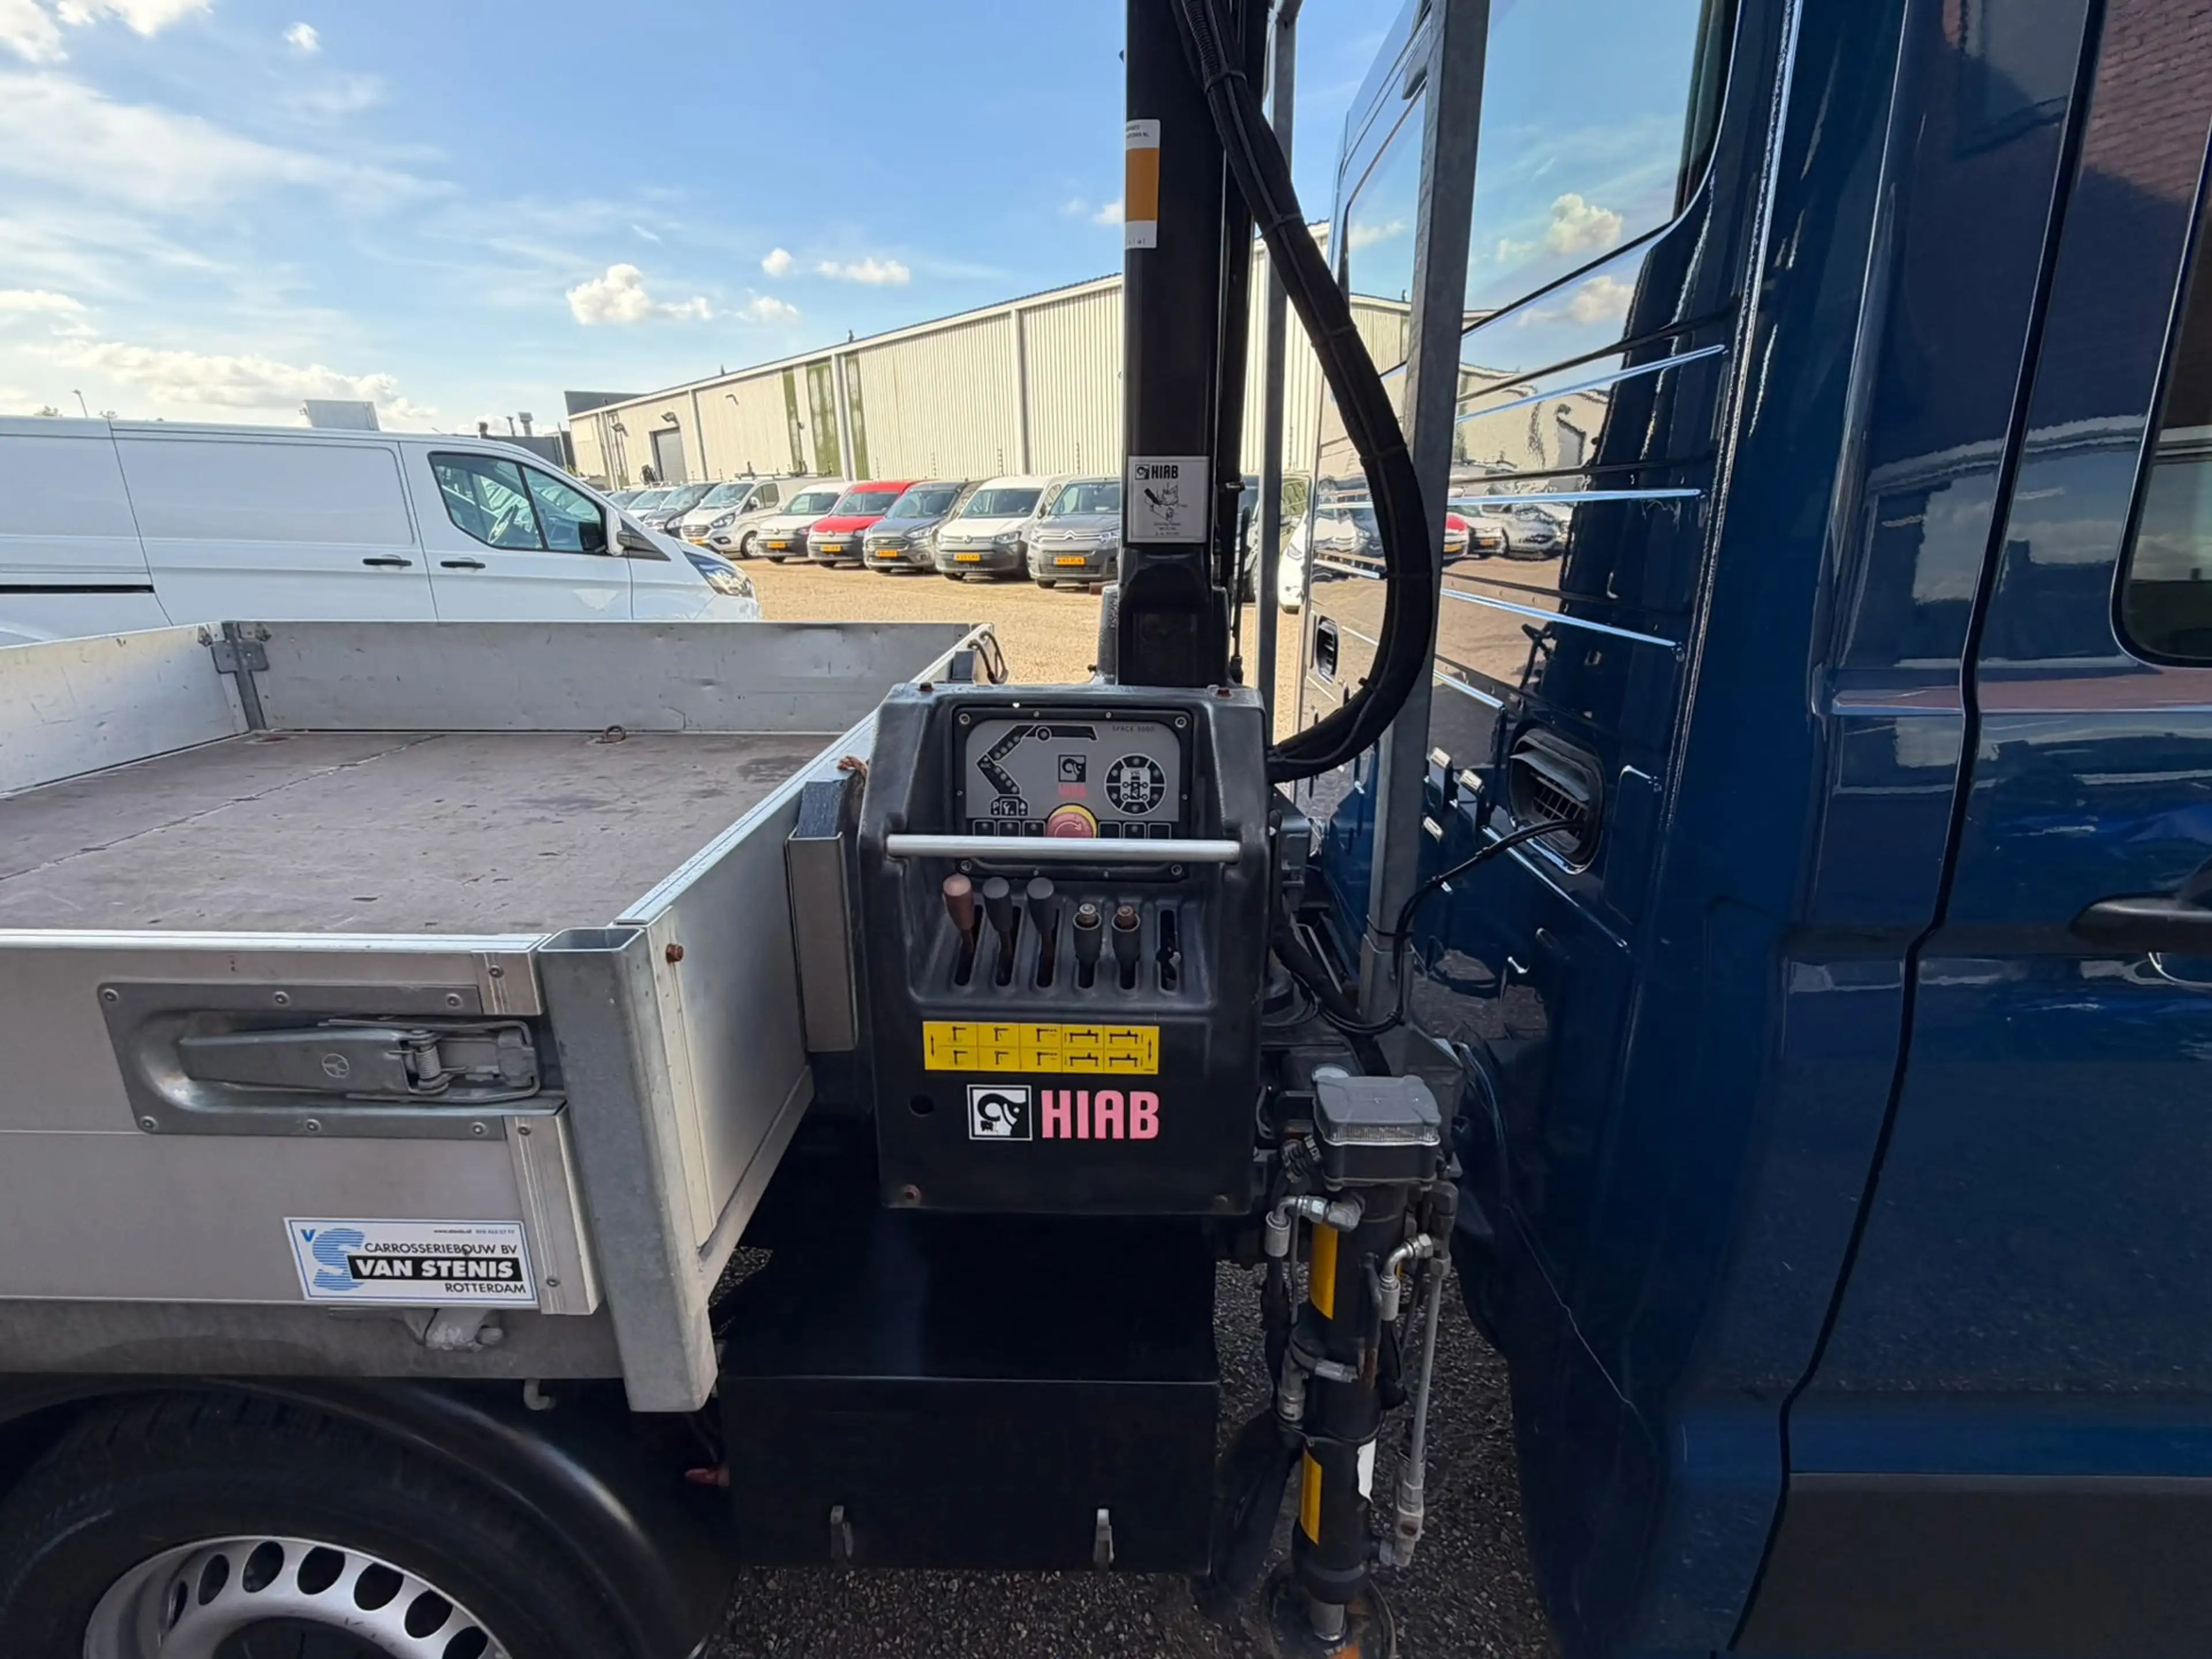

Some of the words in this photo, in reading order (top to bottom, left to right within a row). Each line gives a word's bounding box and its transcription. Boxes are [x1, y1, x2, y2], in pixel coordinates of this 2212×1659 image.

[1152, 465, 1179, 479] HIAB
[1041, 1090, 1159, 1139] HIAB
[365, 1243, 496, 1255] CARROSSERIEBOUW
[501, 1244, 517, 1255] BV
[355, 1259, 413, 1277] VAN
[422, 1260, 514, 1278] STENIS
[445, 1283, 527, 1294] ROTTERDAM
